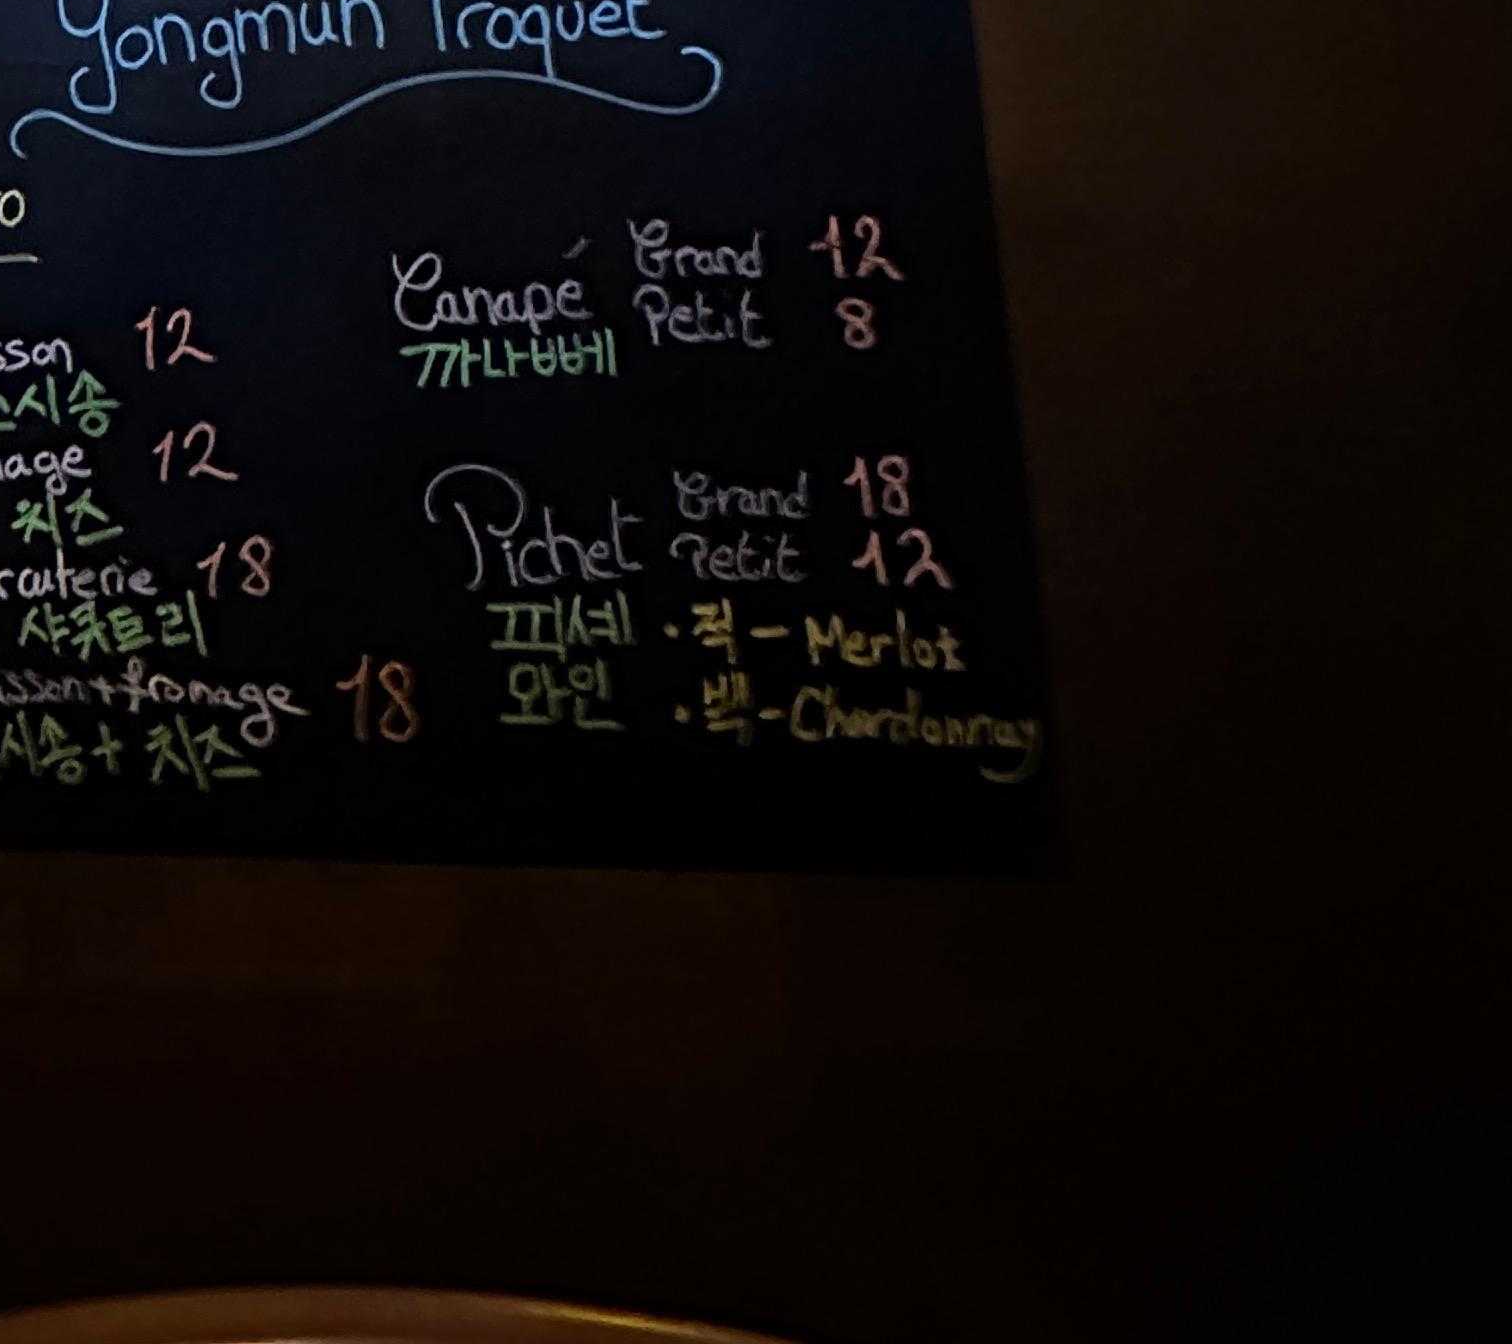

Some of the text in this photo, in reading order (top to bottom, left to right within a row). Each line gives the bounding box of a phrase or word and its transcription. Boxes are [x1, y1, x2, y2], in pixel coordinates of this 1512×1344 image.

[625, 213, 906, 282] Grand 12
[391, 235, 593, 335] Canapé
[632, 283, 879, 350] Petit 8
[134, 305, 218, 371] 12
[152, 421, 240, 483] 12
[10, 487, 125, 548] 치즈
[671, 453, 914, 522] Grand 18
[424, 463, 648, 592] Pichet
[668, 525, 957, 591] Petit 12
[196, 535, 276, 599] 18
[804, 608, 969, 672] Merlot
[335, 652, 424, 744] 18
[496, 658, 631, 733] 와인
[145, 712, 264, 794] 치즈
